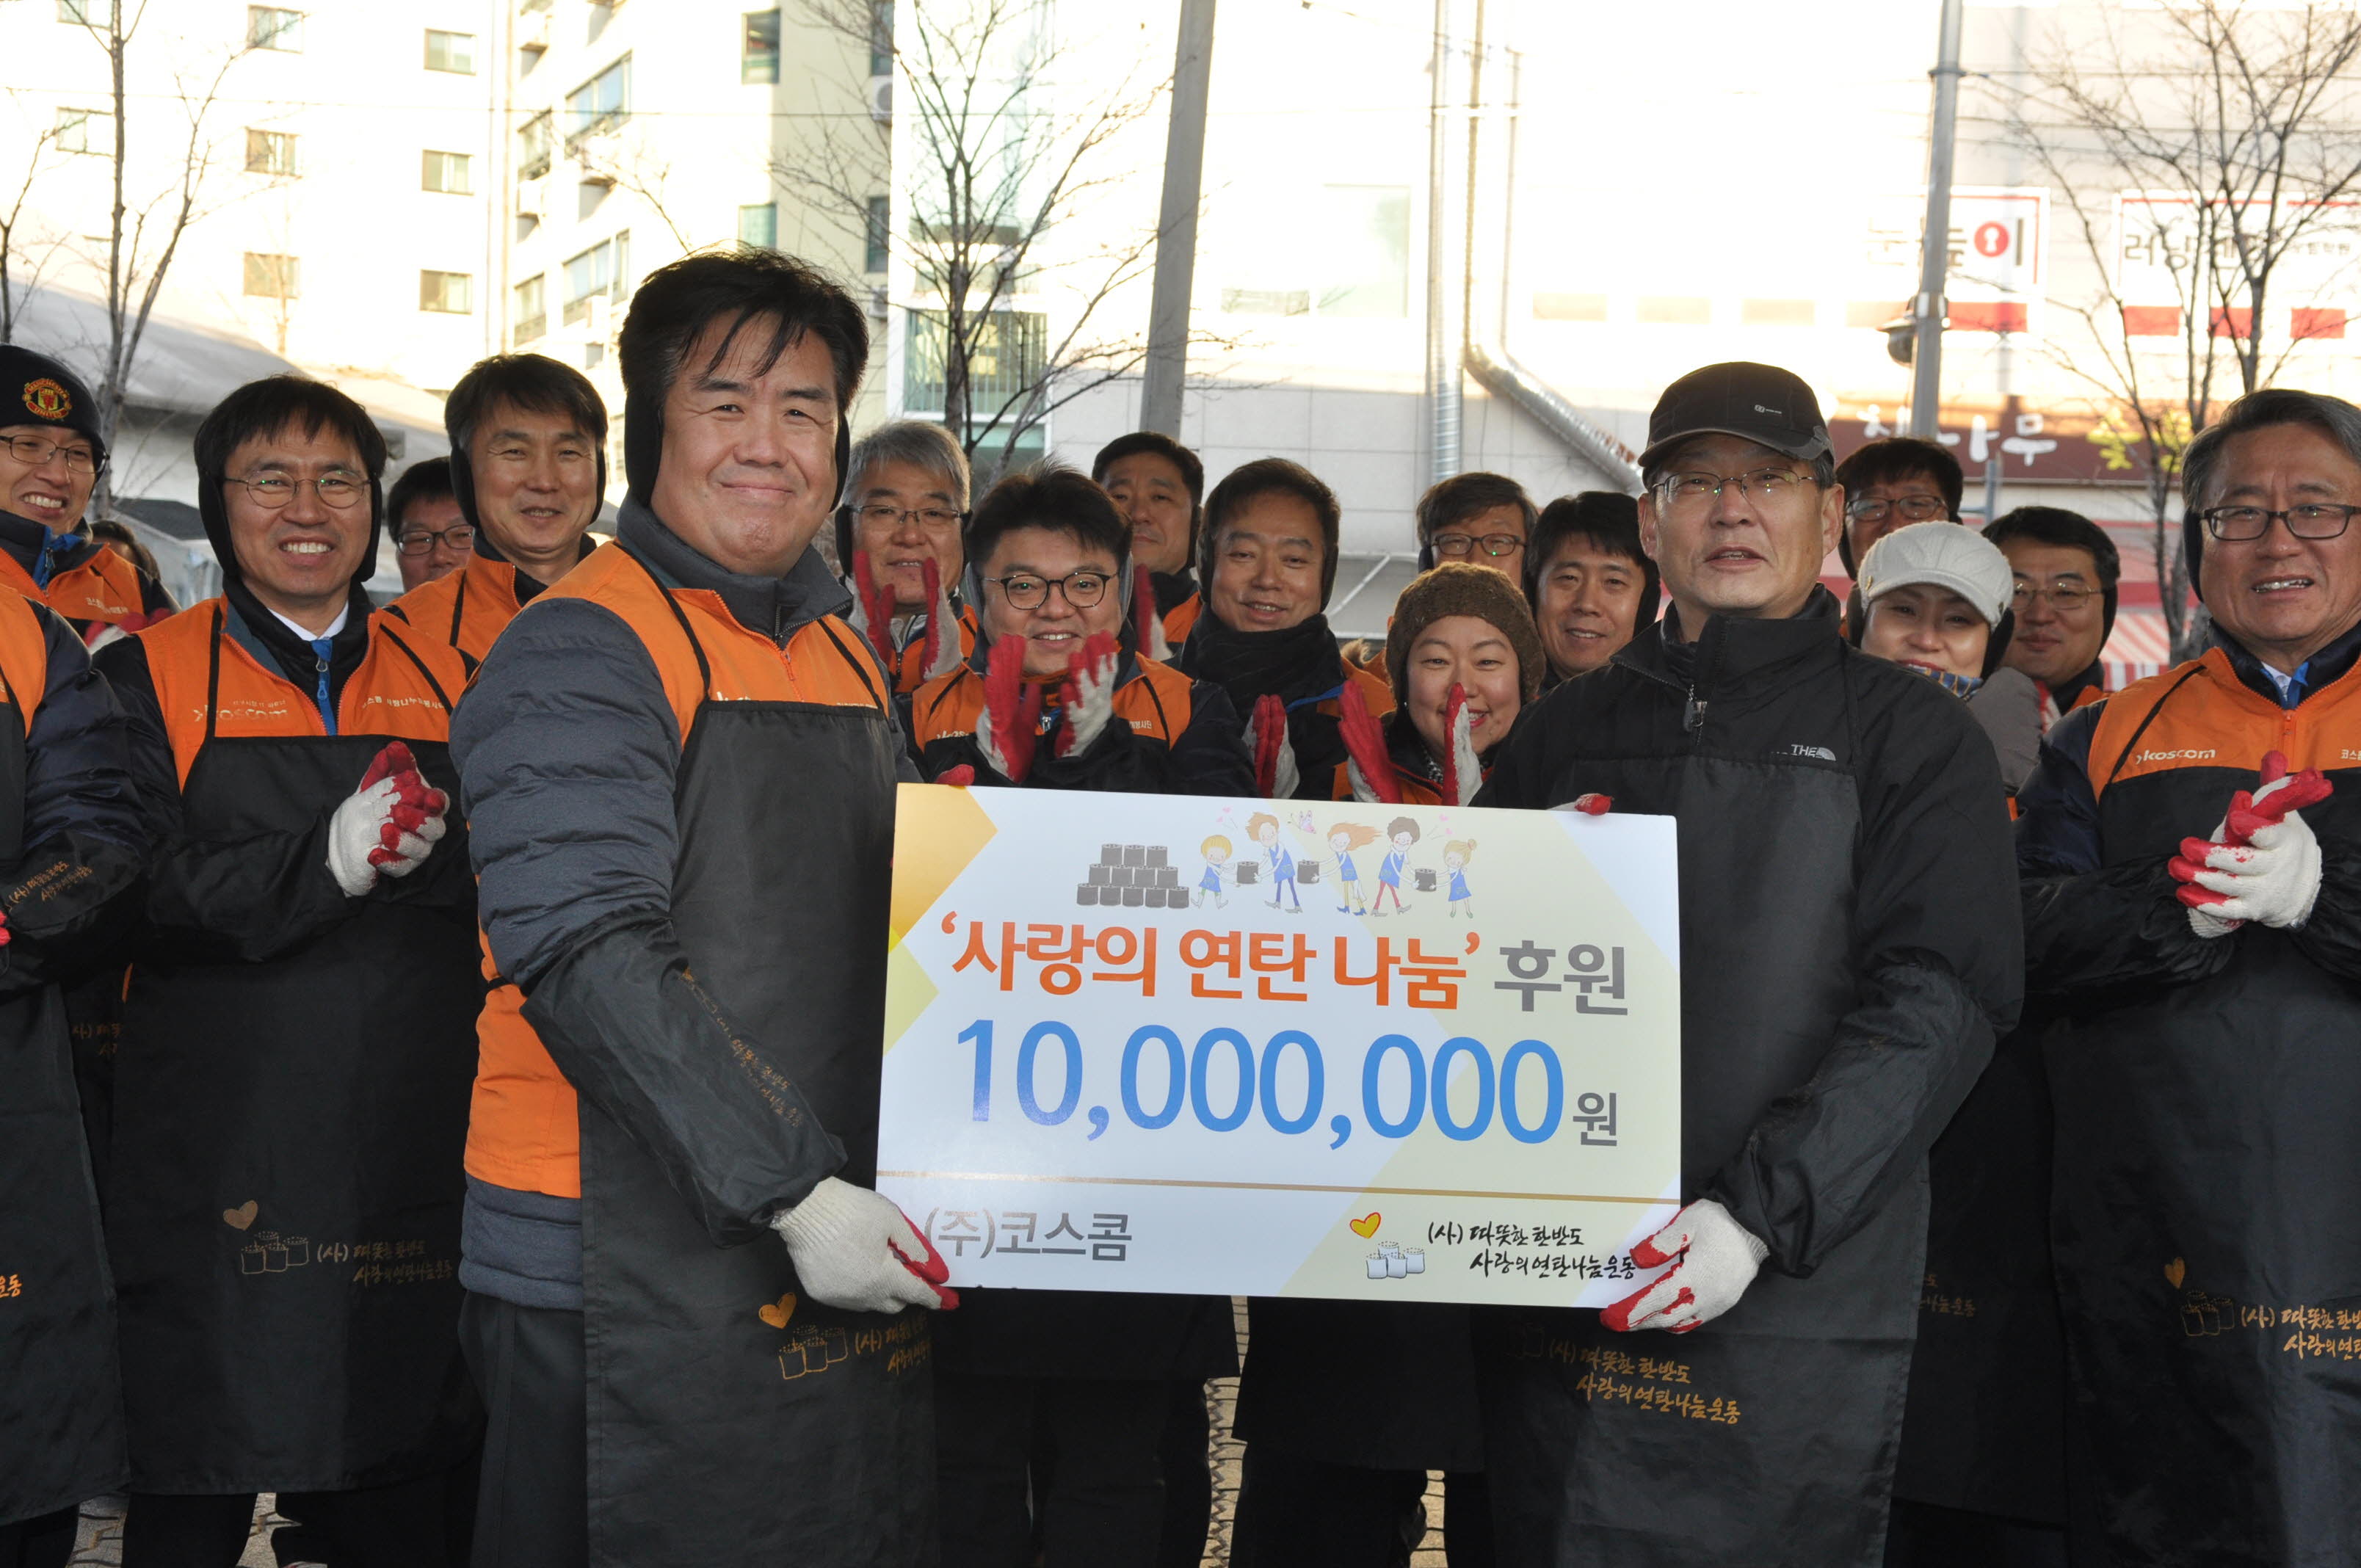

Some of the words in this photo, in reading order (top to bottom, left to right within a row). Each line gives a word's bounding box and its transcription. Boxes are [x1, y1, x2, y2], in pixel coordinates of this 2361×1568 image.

[1791, 744, 1817, 758] THE
[2143, 749, 2216, 762] koscom
[1179, 929, 1318, 1002] 연탄
[1494, 940, 1628, 1016] 후원
[924, 1207, 1133, 1262] (주)코스콤
[1428, 1221, 1464, 1245] (사)
[1469, 1221, 1528, 1247] 따뜻한
[1532, 1225, 1585, 1247] 한반도
[2241, 1304, 2275, 1328] (사)
[2281, 1304, 2334, 1330] 따뜻한
[1579, 1346, 1635, 1375] 따뜻한
[1638, 1357, 1692, 1384] 한반도
